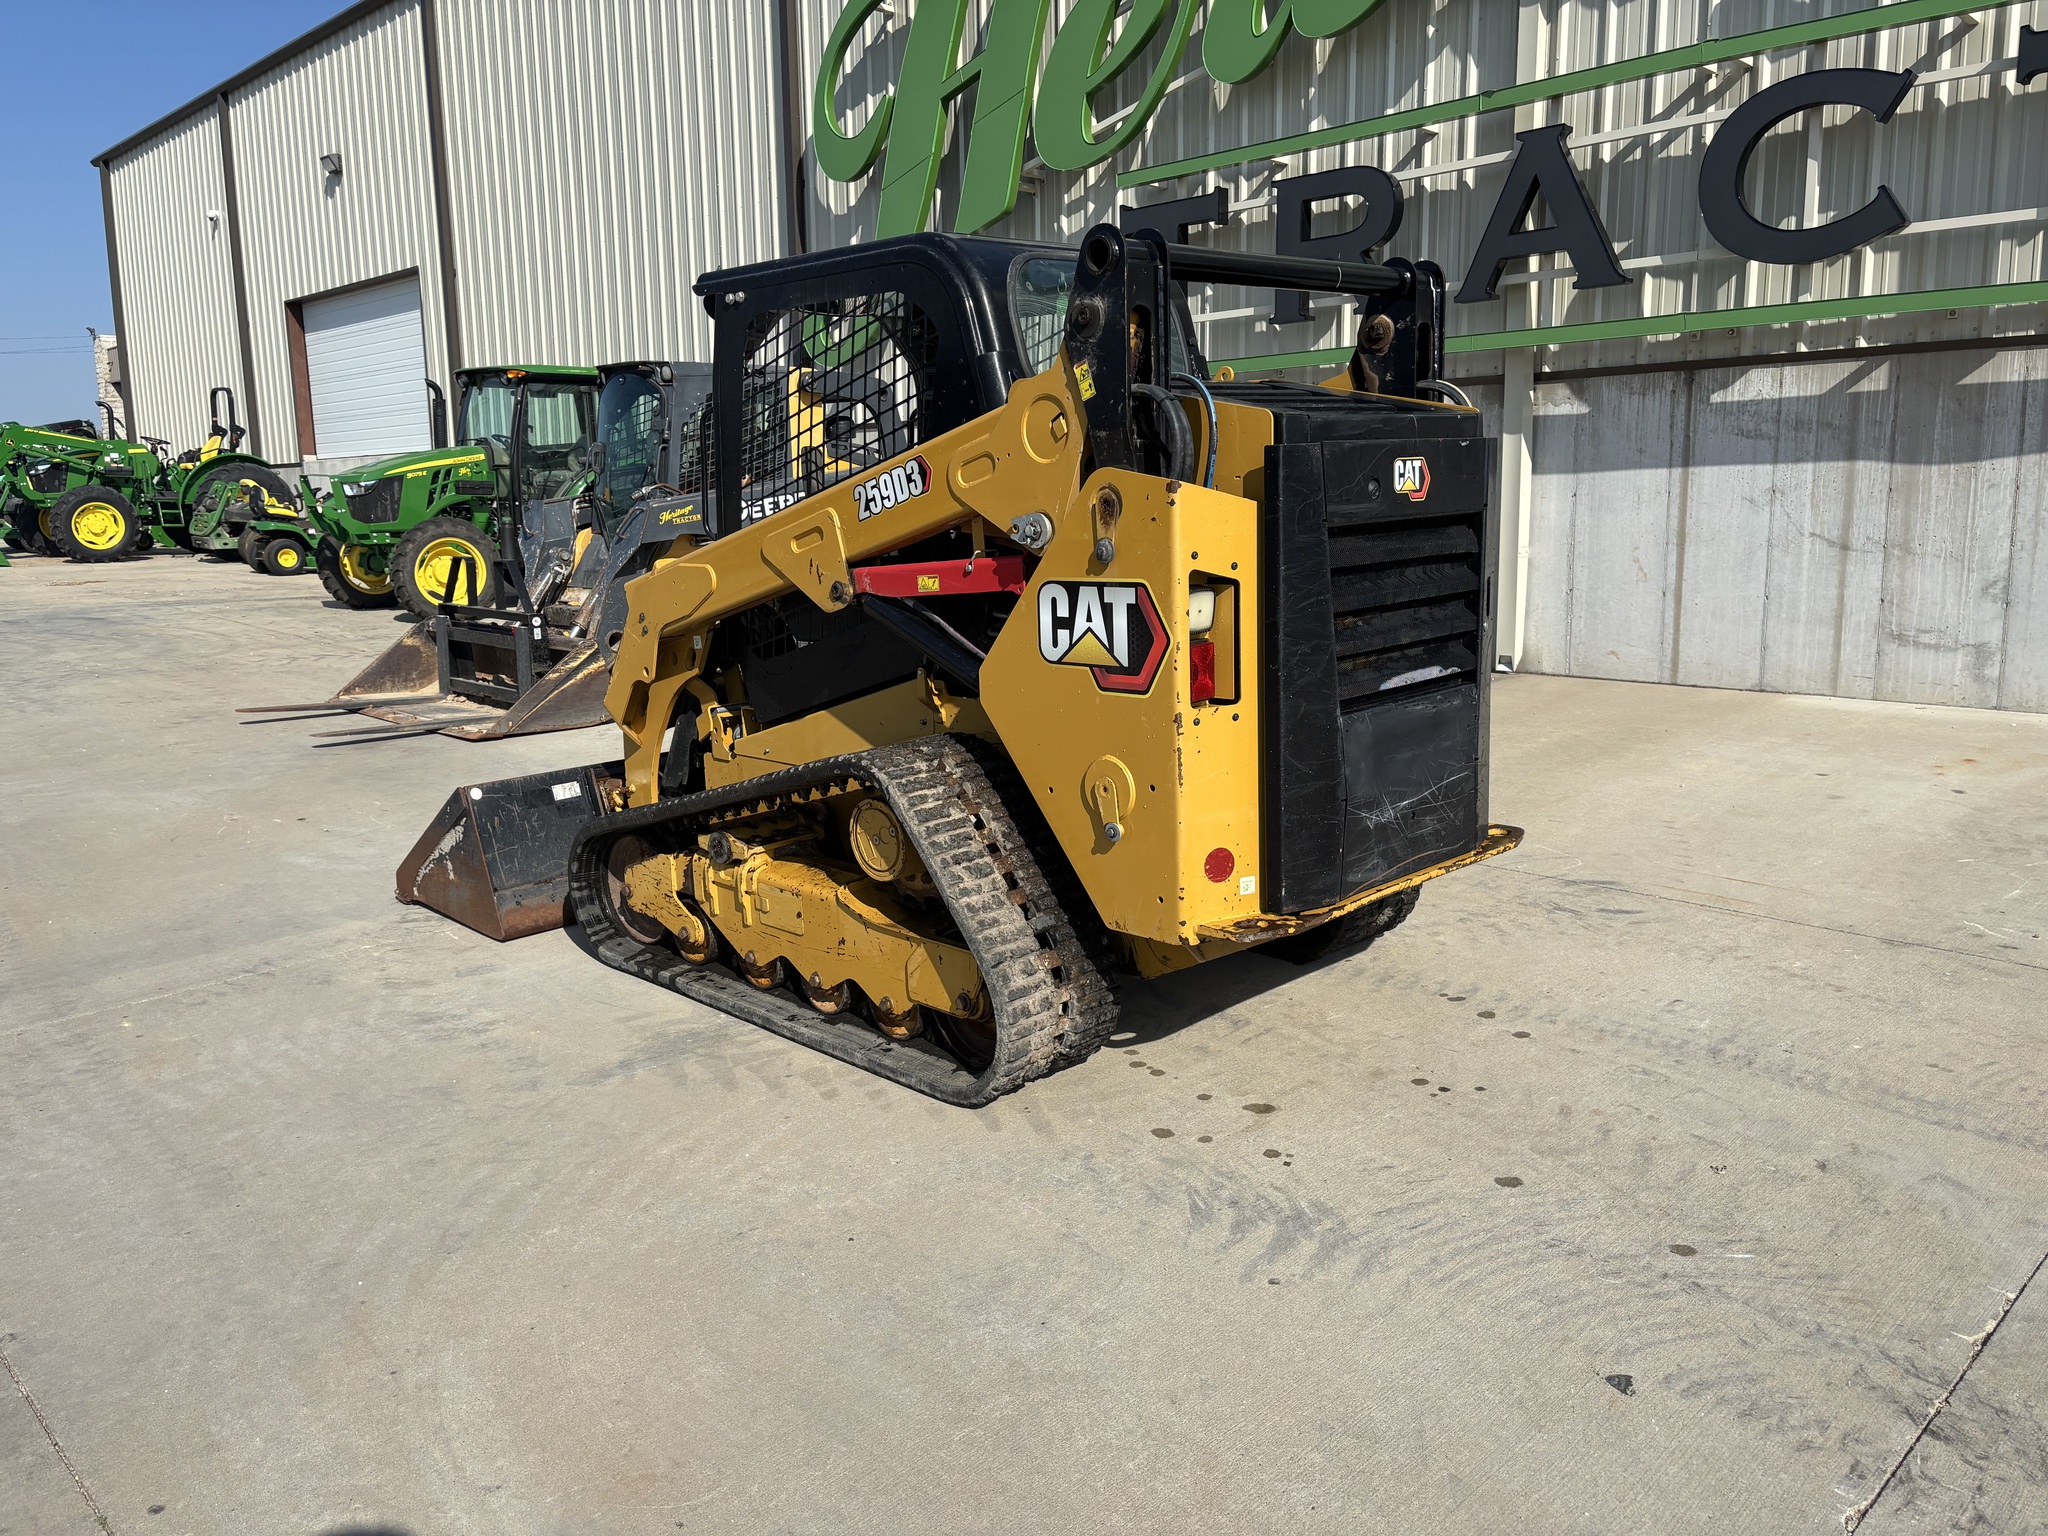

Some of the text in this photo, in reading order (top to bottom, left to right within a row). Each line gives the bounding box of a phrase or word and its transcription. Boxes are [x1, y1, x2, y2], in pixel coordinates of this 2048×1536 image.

[1120, 24, 2048, 324] TRAC
[853, 459, 923, 521] 259D3
[1395, 460, 1422, 491] CAT
[659, 505, 694, 525] Heritage
[1039, 583, 1136, 668] CAT
